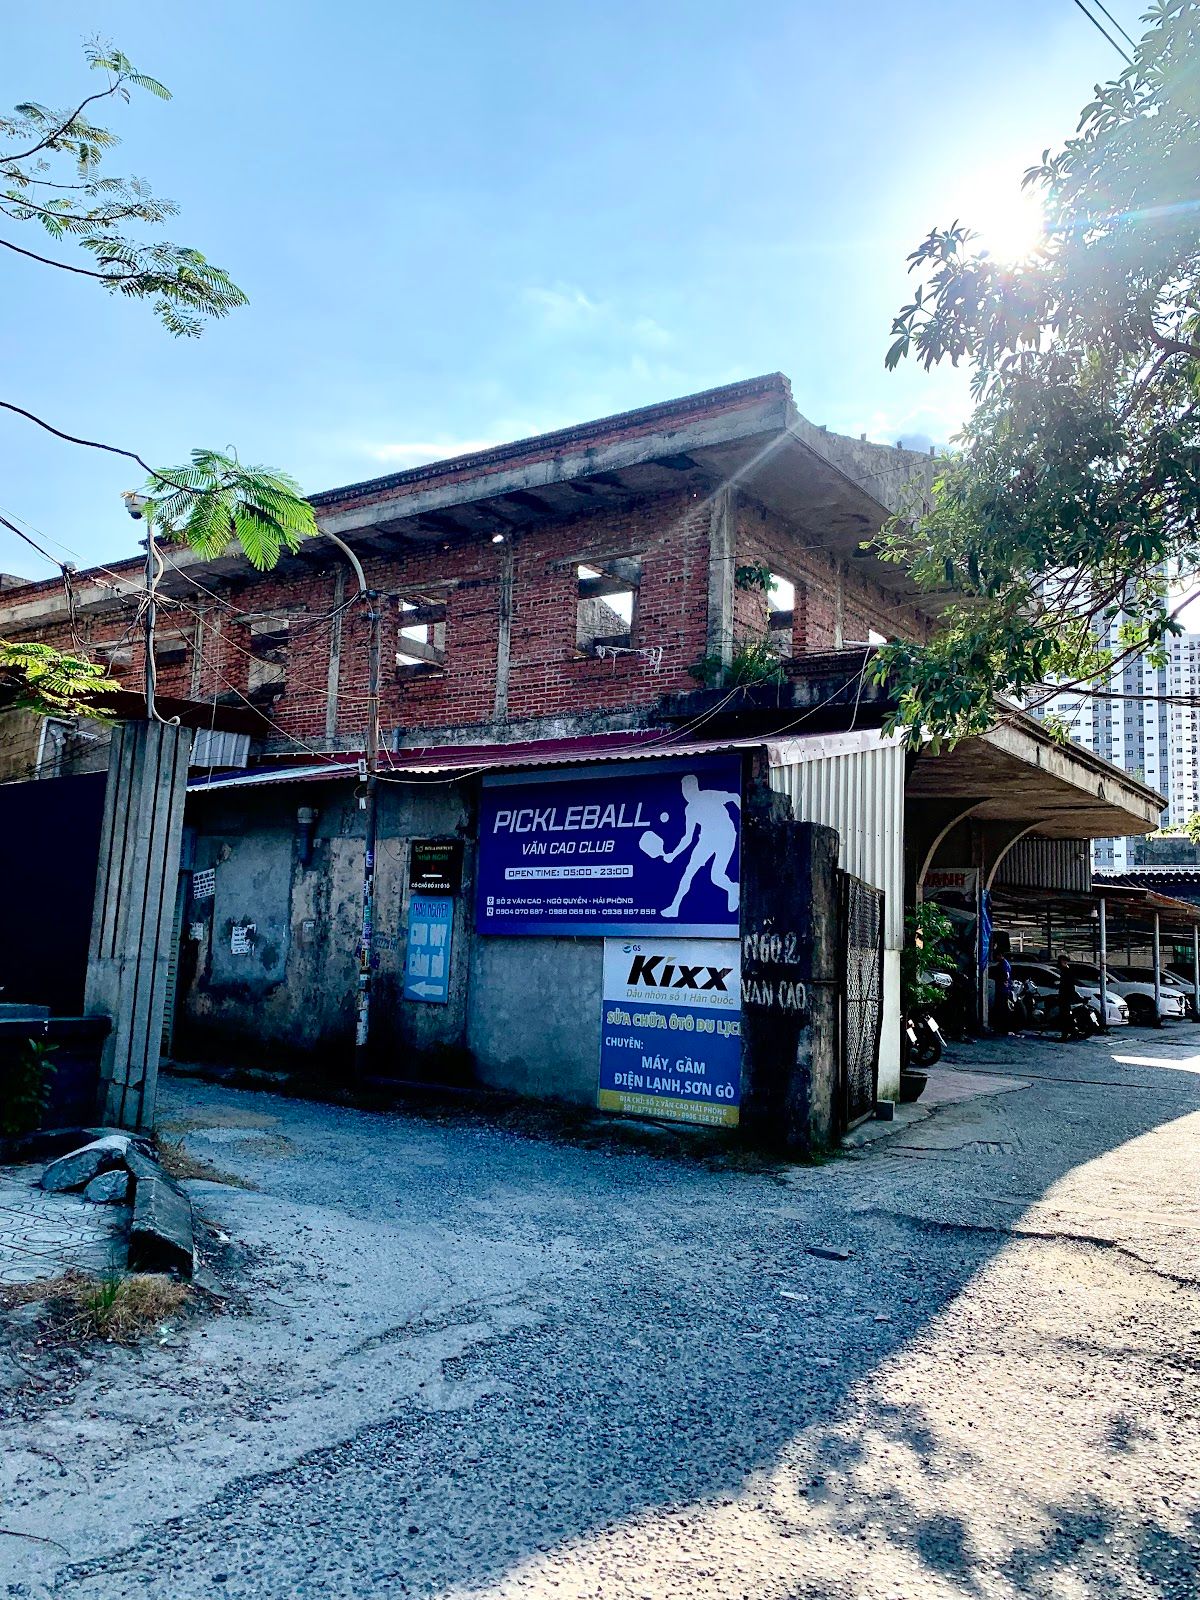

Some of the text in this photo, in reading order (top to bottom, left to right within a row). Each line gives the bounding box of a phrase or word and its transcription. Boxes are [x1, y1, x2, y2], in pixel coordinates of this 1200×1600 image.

[493, 802, 650, 833] PICKLEBALL
[522, 840, 615, 855] VĂN CAO CLUB
[536, 869, 560, 877] TIME:
[563, 868, 592, 876] 05:00
[600, 867, 629, 875] 23:00
[606, 896, 634, 904] PHÒNG
[627, 955, 733, 991] Kixx
[778, 980, 806, 1009] CAO
[606, 1007, 632, 1026] SỬA
[632, 1011, 668, 1030] CHỮA
[669, 1013, 695, 1031] ÔTÔ
[696, 1018, 715, 1033] DU
[605, 1036, 644, 1050] CHUYÊN:
[641, 1054, 706, 1074] MÁY, GẦM
[614, 1071, 643, 1089] ĐIỆN
[715, 1082, 735, 1099] GÒ
[675, 1102, 688, 1111] CAO
